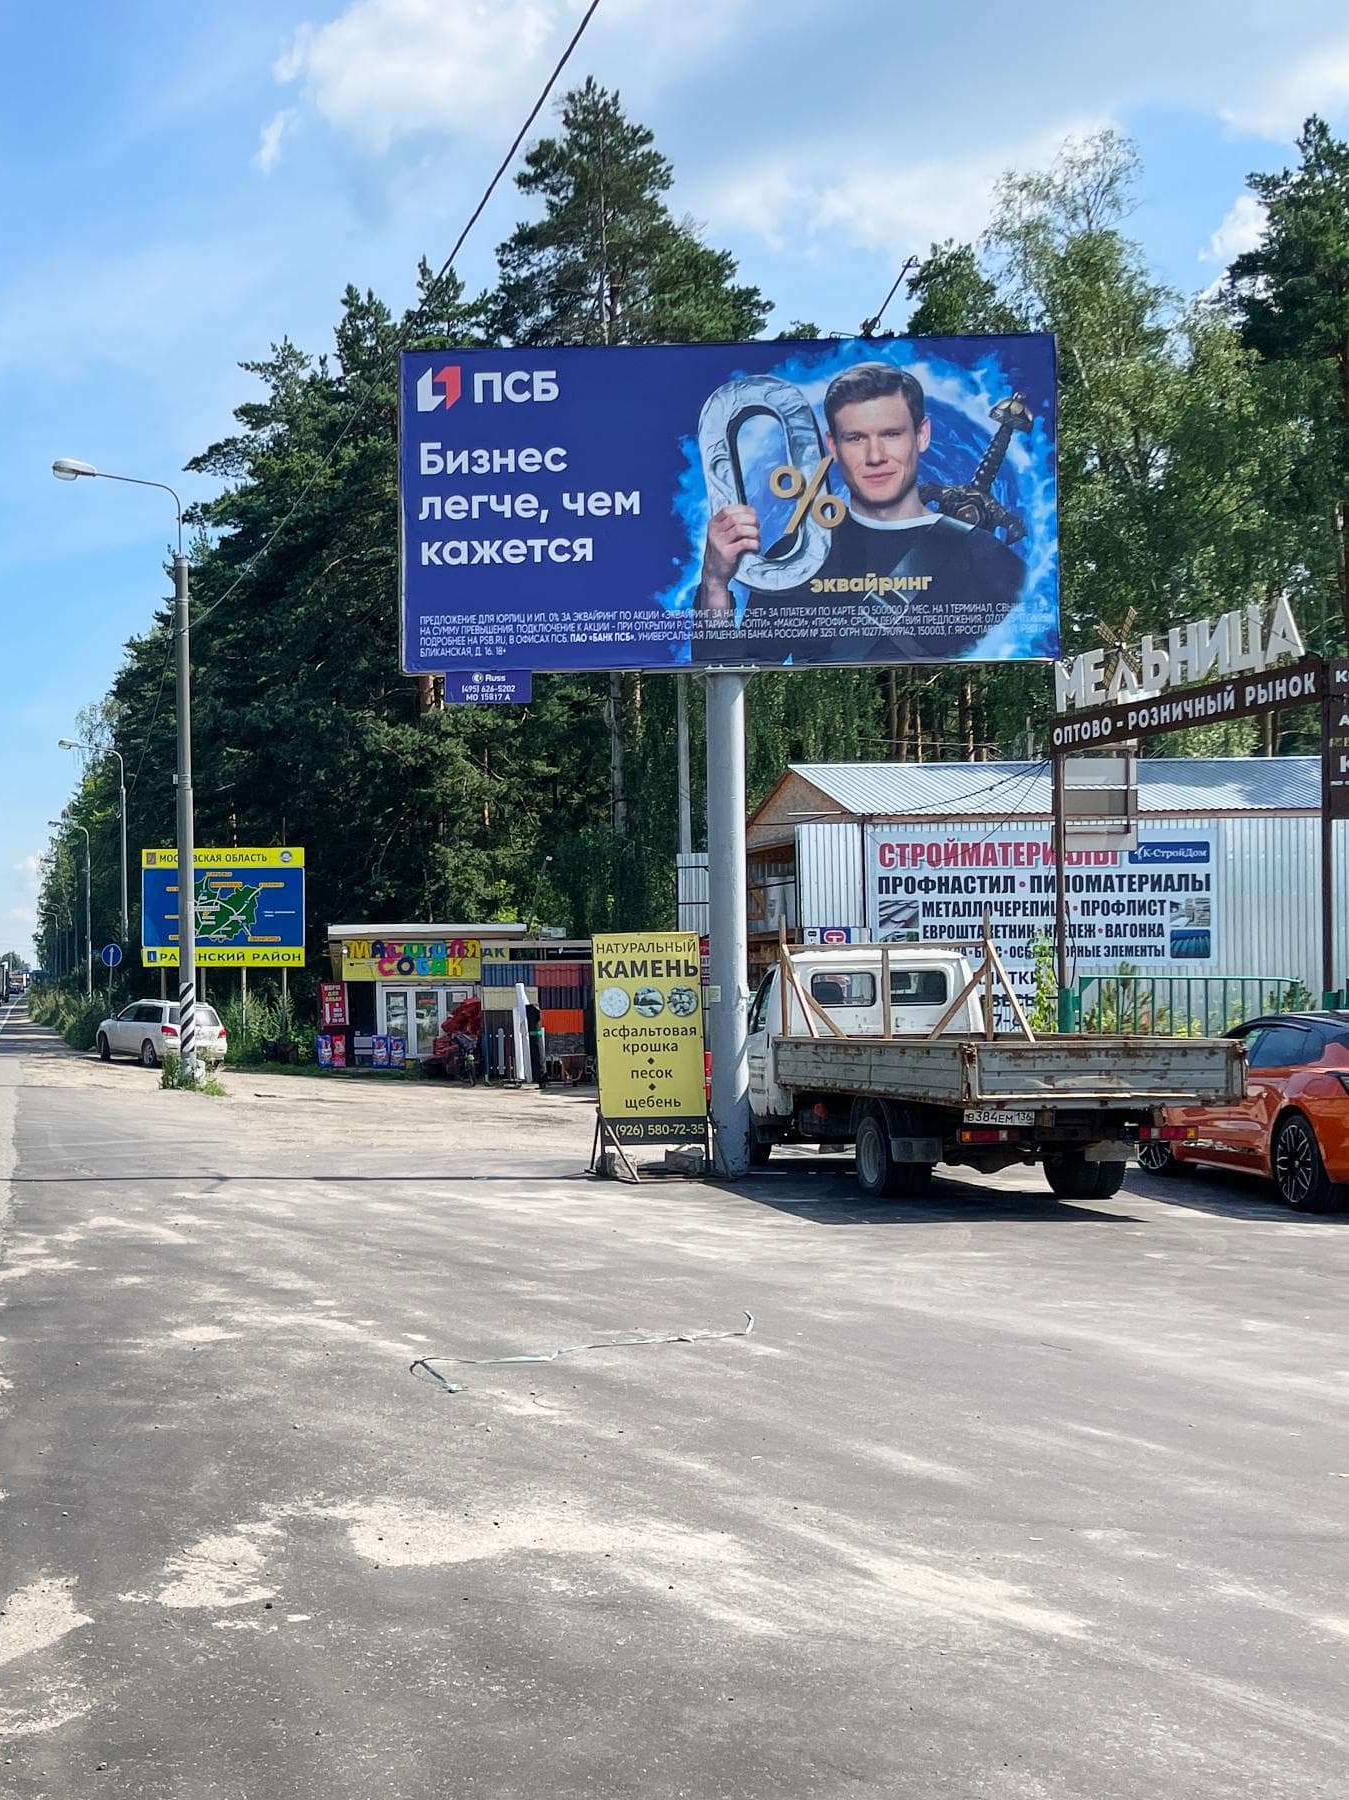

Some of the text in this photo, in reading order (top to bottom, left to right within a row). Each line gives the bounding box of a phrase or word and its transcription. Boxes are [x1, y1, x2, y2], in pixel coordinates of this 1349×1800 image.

[473, 370, 559, 403] ПСБ
[420, 442, 567, 475] Бизнес
[418, 490, 641, 524] легче, чем
[421, 537, 593, 566] кажется
[810, 573, 932, 595] эквайринг
[420, 614, 476, 625] ПРЕДЛОЖЕНИЕ
[478, 614, 495, 625] ДЛЯ
[496, 613, 526, 624] ЮРЛИЦ
[527, 613, 533, 622] И
[534, 613, 547, 622] ИП.
[561, 612, 571, 622] ЗА
[573, 610, 618, 621] ЭКВАЙРИНГ
[620, 611, 630, 620] ПО
[633, 610, 660, 620] АКЦИИ
[712, 608, 722, 618] ЗА
[769, 607, 778, 617] ЗА
[780, 606, 817, 616] ПЛАТЕЖИ
[819, 606, 831, 616] ПО
[832, 606, 855, 616] КАРТЕ
[857, 605, 870, 616] ДО
[933, 604, 944, 613] НА
[420, 626, 431, 636] НА
[433, 625, 459, 635] СУММУ
[461, 624, 515, 635] ПРЕВЫШЕНИЯ.
[516, 623, 575, 634] ПОДКЛЮЧЕНИЕ
[577, 623, 582, 632] К
[583, 621, 610, 632] АКЦИИ
[617, 621, 634, 631] ПРИ
[635, 620, 675, 631] ОТКРЫТИИ
[693, 620, 702, 629] НА
[420, 636, 466, 646] ПОДРОБНЕЕ
[468, 636, 478, 645] НА
[509, 635, 515, 644] В
[516, 634, 550, 644] ОФИСАХ
[570, 633, 587, 643] ПАО
[638, 630, 704, 641] УНИВЕРСАЛЬНАЯ
[706, 629, 746, 640] ЛИЦЕНЗИЯ
[748, 629, 773, 639] БАНКА
[774, 628, 809, 639] РОССИИ
[839, 628, 860, 638] ОГРН
[1054, 593, 1305, 713] МЕЛЬНИЦА
[485, 674, 506, 682] Russ
[1053, 717, 1112, 745] ОПТОВО
[1128, 685, 1235, 730] РОЗНИЧНЫЙ
[1245, 671, 1316, 707] РЫНОК
[159, 853, 267, 862] МОСВСКАЯ ОБЛАСТЬ
[1143, 844, 1207, 859] К-СтройДом
[878, 876, 1015, 894] ПРОФНАСТИЛ
[1080, 900, 1167, 916] ПРОФЛИСТ
[1044, 924, 1096, 938] КПЕЖ
[1105, 923, 1165, 938] ВАГОНКА
[596, 939, 696, 954] НАТУРАЛЬНЫЙ
[1104, 945, 1165, 958] ЭЛЕМЕНТЫ
[160, 949, 301, 961] РАНСКИЙ РАЙОН
[377, 956, 462, 977] СОБАК
[597, 959, 699, 979] КАМЕНЬ
[602, 1025, 697, 1039] асфальтовая
[623, 1042, 679, 1055] крошка
[631, 1068, 673, 1079] песок
[625, 1096, 681, 1109] щебень
[615, 1124, 644, 1138] (926)
[648, 1124, 705, 1135] 580-72-35
